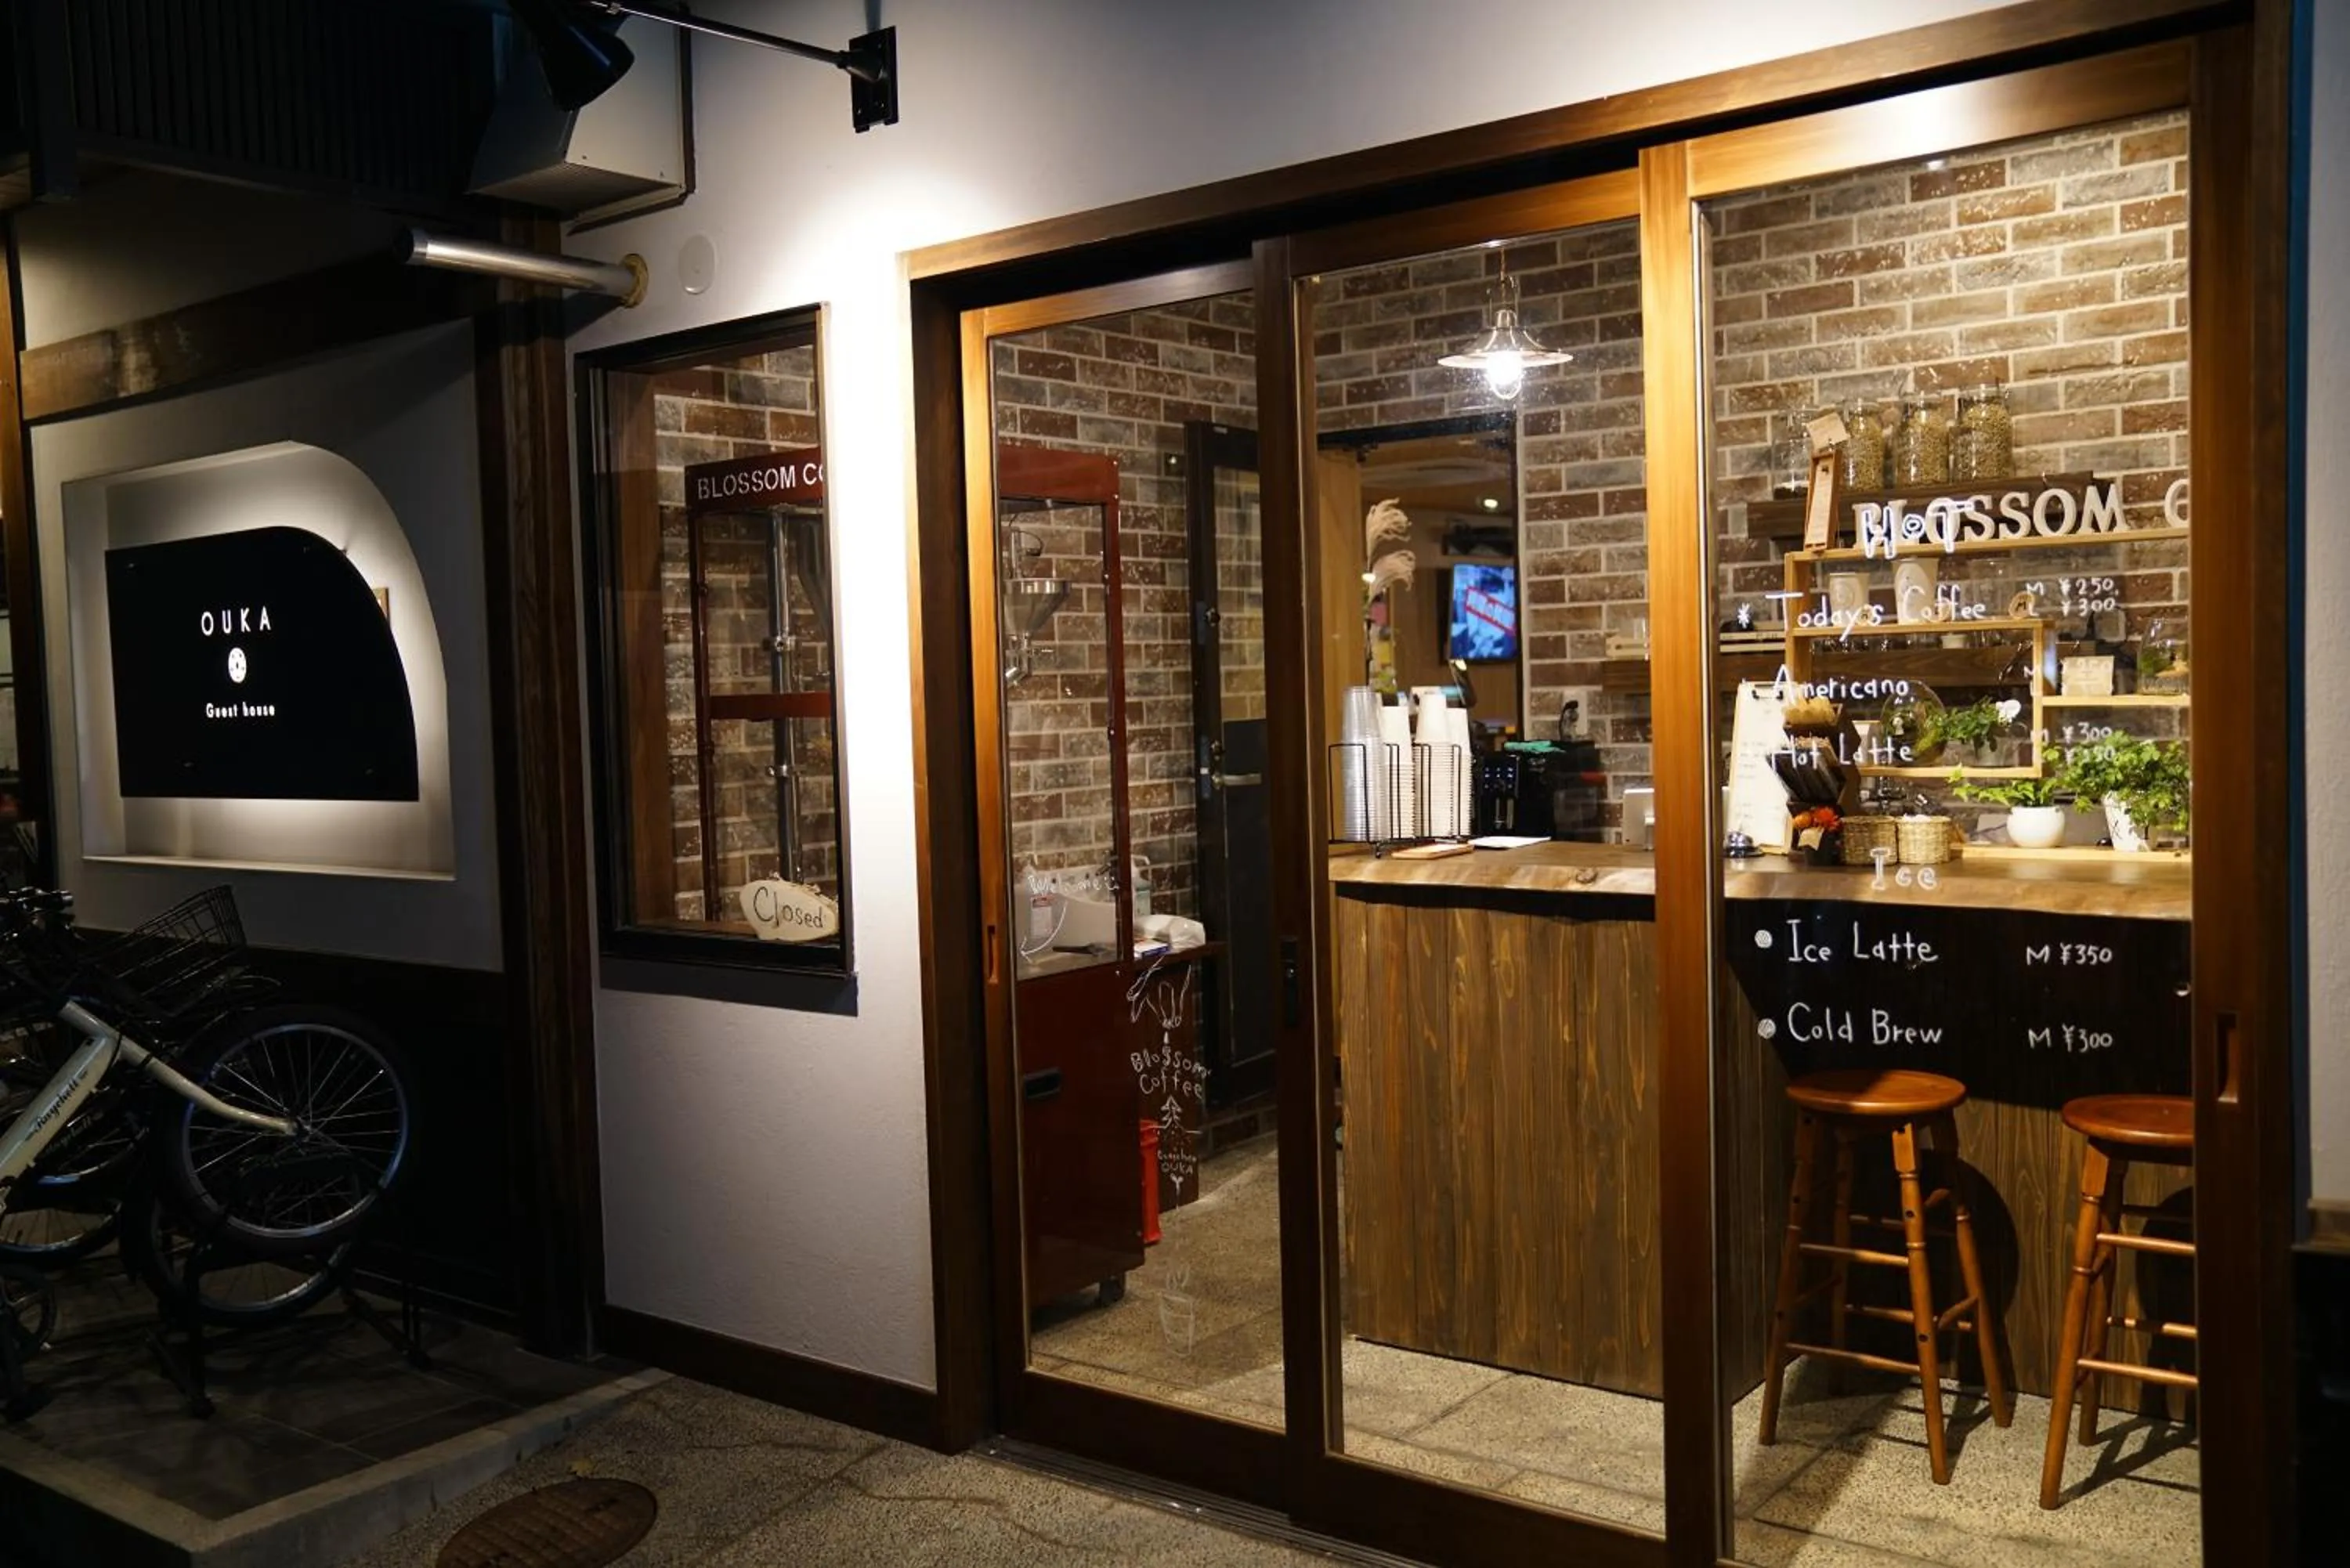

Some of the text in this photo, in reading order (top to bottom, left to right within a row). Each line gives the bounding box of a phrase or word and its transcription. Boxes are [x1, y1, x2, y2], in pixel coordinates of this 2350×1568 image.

[698, 465, 796, 500] BLOSSOM
[201, 605, 271, 636] OUKA
[1904, 584, 1987, 622] Coffee
[2025, 581, 2044, 596] M
[2060, 597, 2116, 617] ¥300
[1773, 664, 1910, 706] Americano
[206, 702, 275, 718] Guest house
[1770, 734, 1821, 771] Hot
[1839, 732, 1914, 766] Latte
[1869, 847, 1938, 891] Ice
[753, 886, 823, 928] Closed
[1785, 919, 2113, 966] Ice Latte M ¥350
[1788, 1002, 2113, 1053] Cold Brew M ¥300
[1141, 1067, 1203, 1100] Coffee
